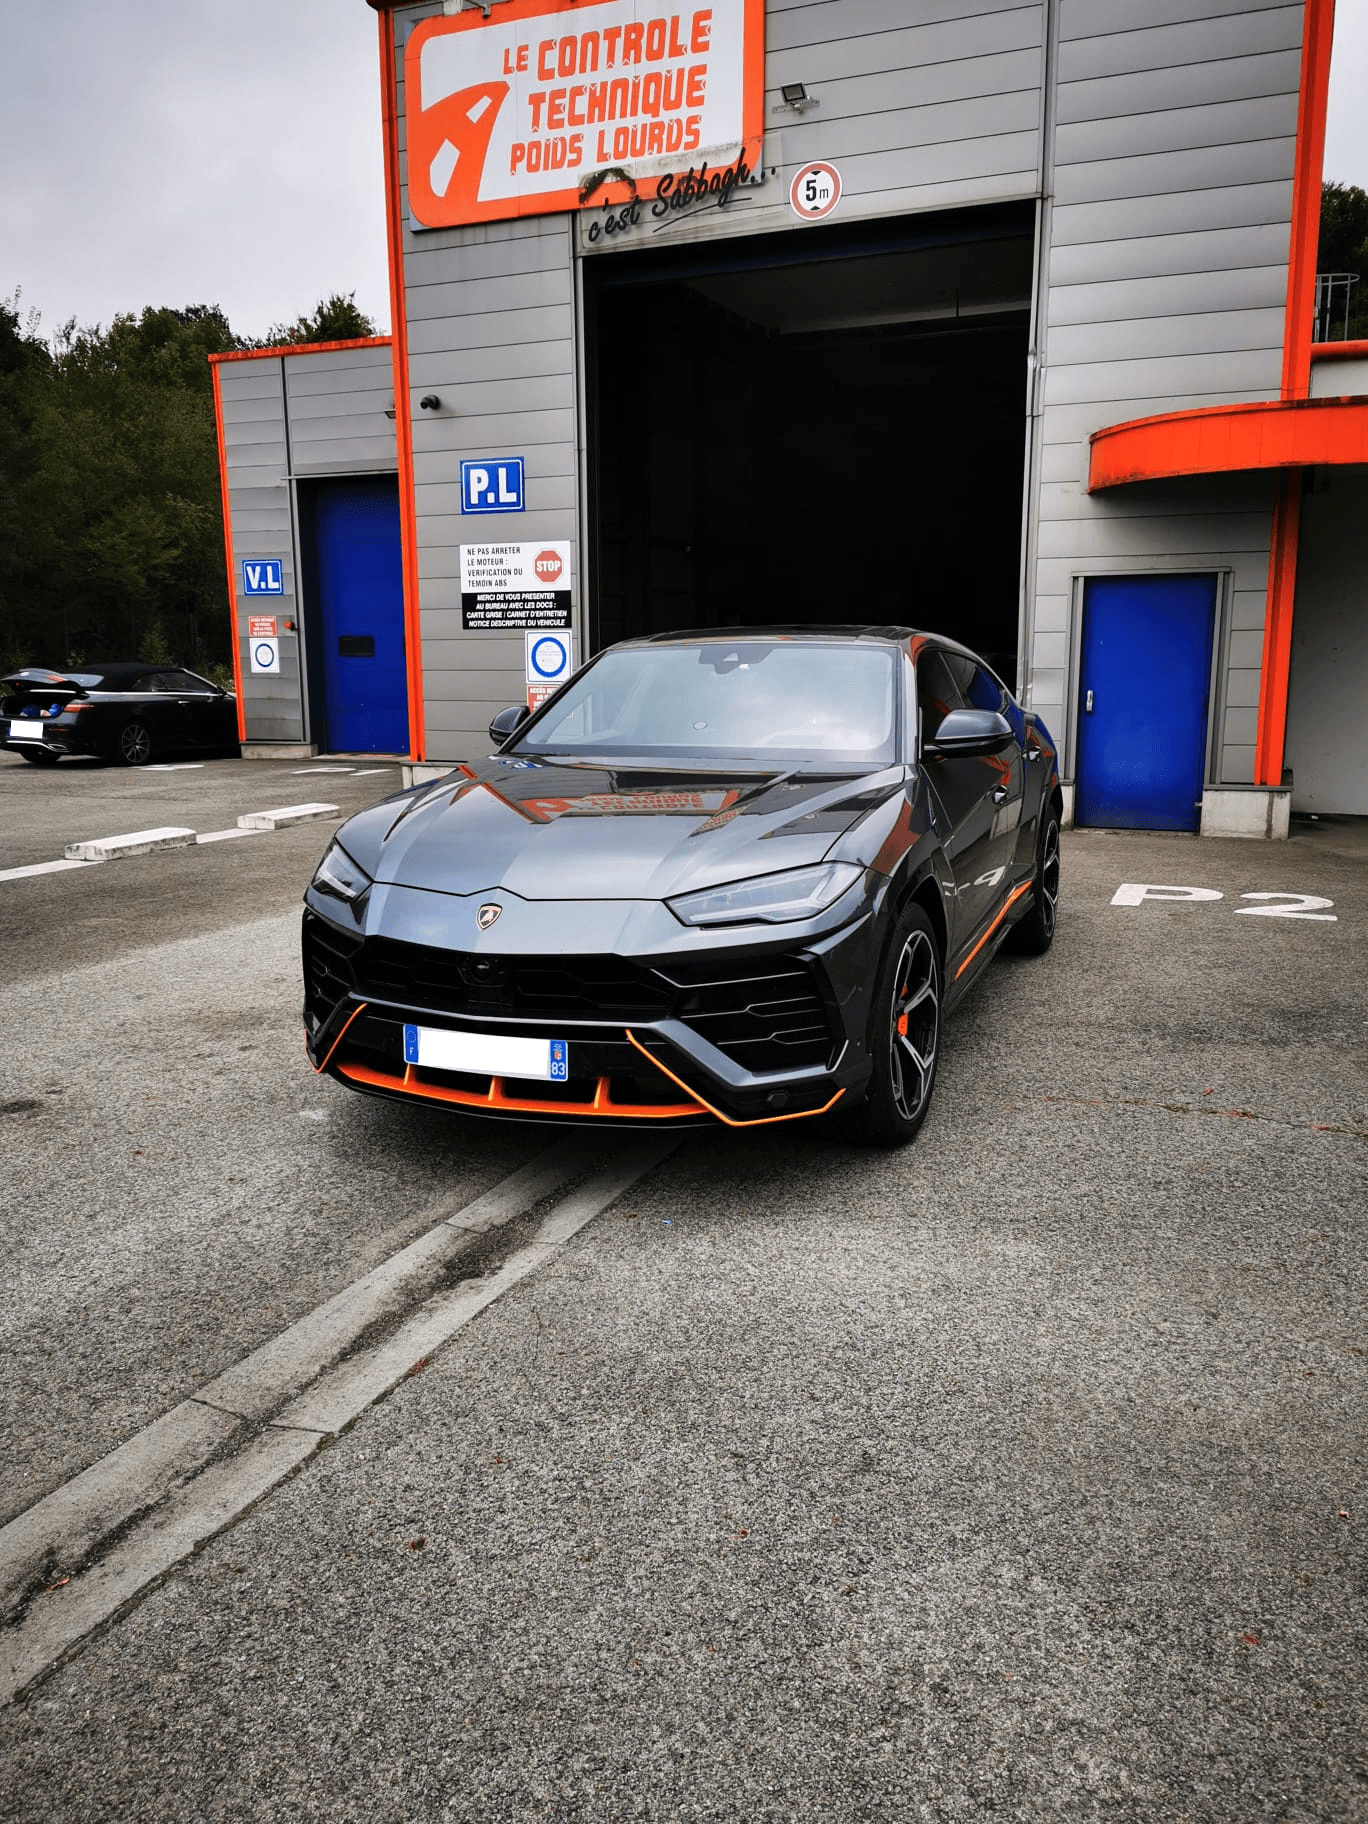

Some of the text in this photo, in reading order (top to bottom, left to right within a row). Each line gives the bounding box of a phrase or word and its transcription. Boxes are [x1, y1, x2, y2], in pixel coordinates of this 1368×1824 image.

[503, 9, 713, 81] LE CONTROLE
[528, 64, 708, 132] TECHNIQUE
[510, 115, 702, 176] POIDS LOURDS
[469, 467, 517, 504] P.L
[467, 546, 521, 556] NE PAS ARRETER
[477, 558, 504, 566] MOTEUR
[536, 560, 561, 573] STOP
[467, 568, 523, 576] VERIFICATION DU
[246, 565, 280, 590] V.L
[468, 579, 508, 588] TEMOIN ABS
[496, 593, 505, 601] DE
[521, 592, 555, 600] PRESENTER
[475, 602, 484, 610] AU
[536, 601, 553, 609] DOCS
[466, 611, 485, 619] CARTE
[506, 610, 530, 618] CARNET
[530, 610, 568, 618] D'ENTRETIEN
[490, 619, 527, 627] DESCRIPTIVE
[527, 619, 537, 627] DU
[537, 618, 566, 626] VEHICULE
[551, 1061, 566, 1076] 83
